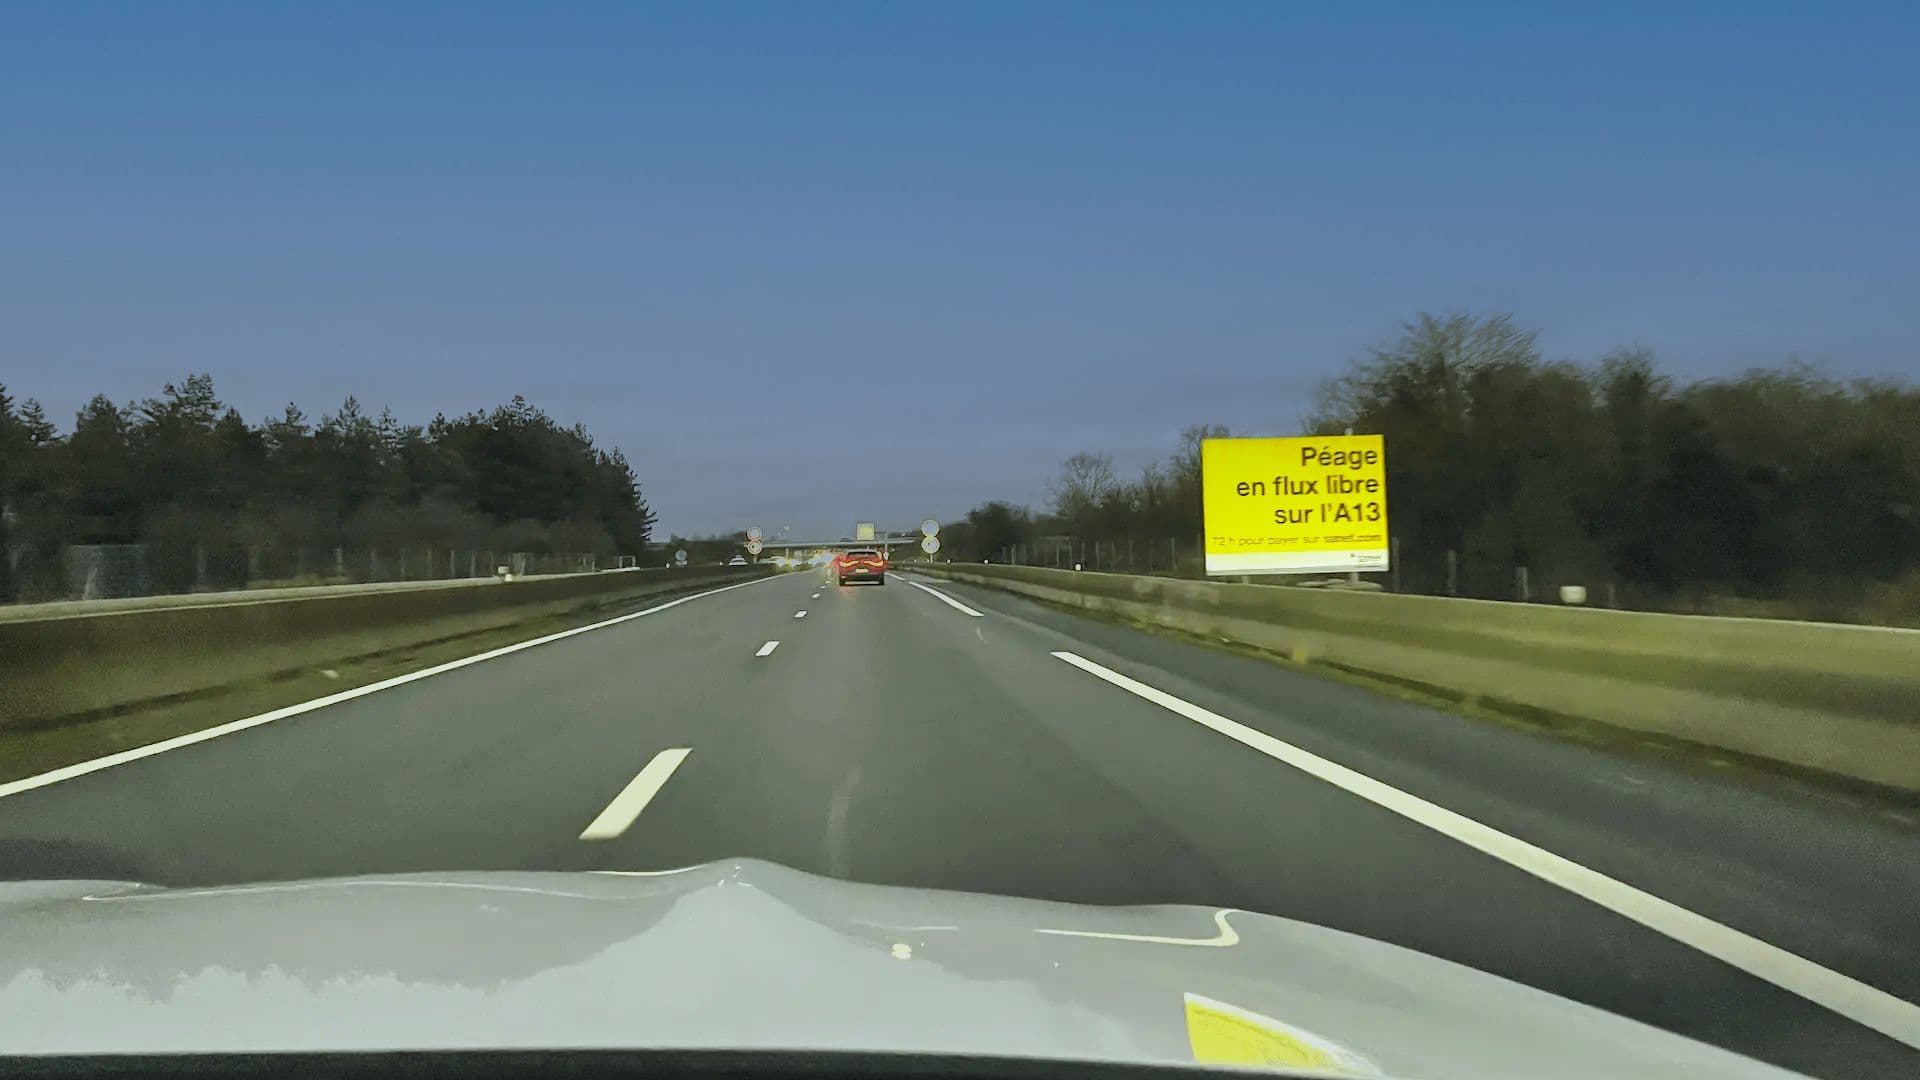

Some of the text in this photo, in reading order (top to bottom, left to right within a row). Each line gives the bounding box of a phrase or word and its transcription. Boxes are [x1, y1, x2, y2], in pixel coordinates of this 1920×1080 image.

[1301, 446, 1378, 470] Péage
[1236, 474, 1379, 496] en flux libre
[1275, 502, 1381, 524] sur l'A13
